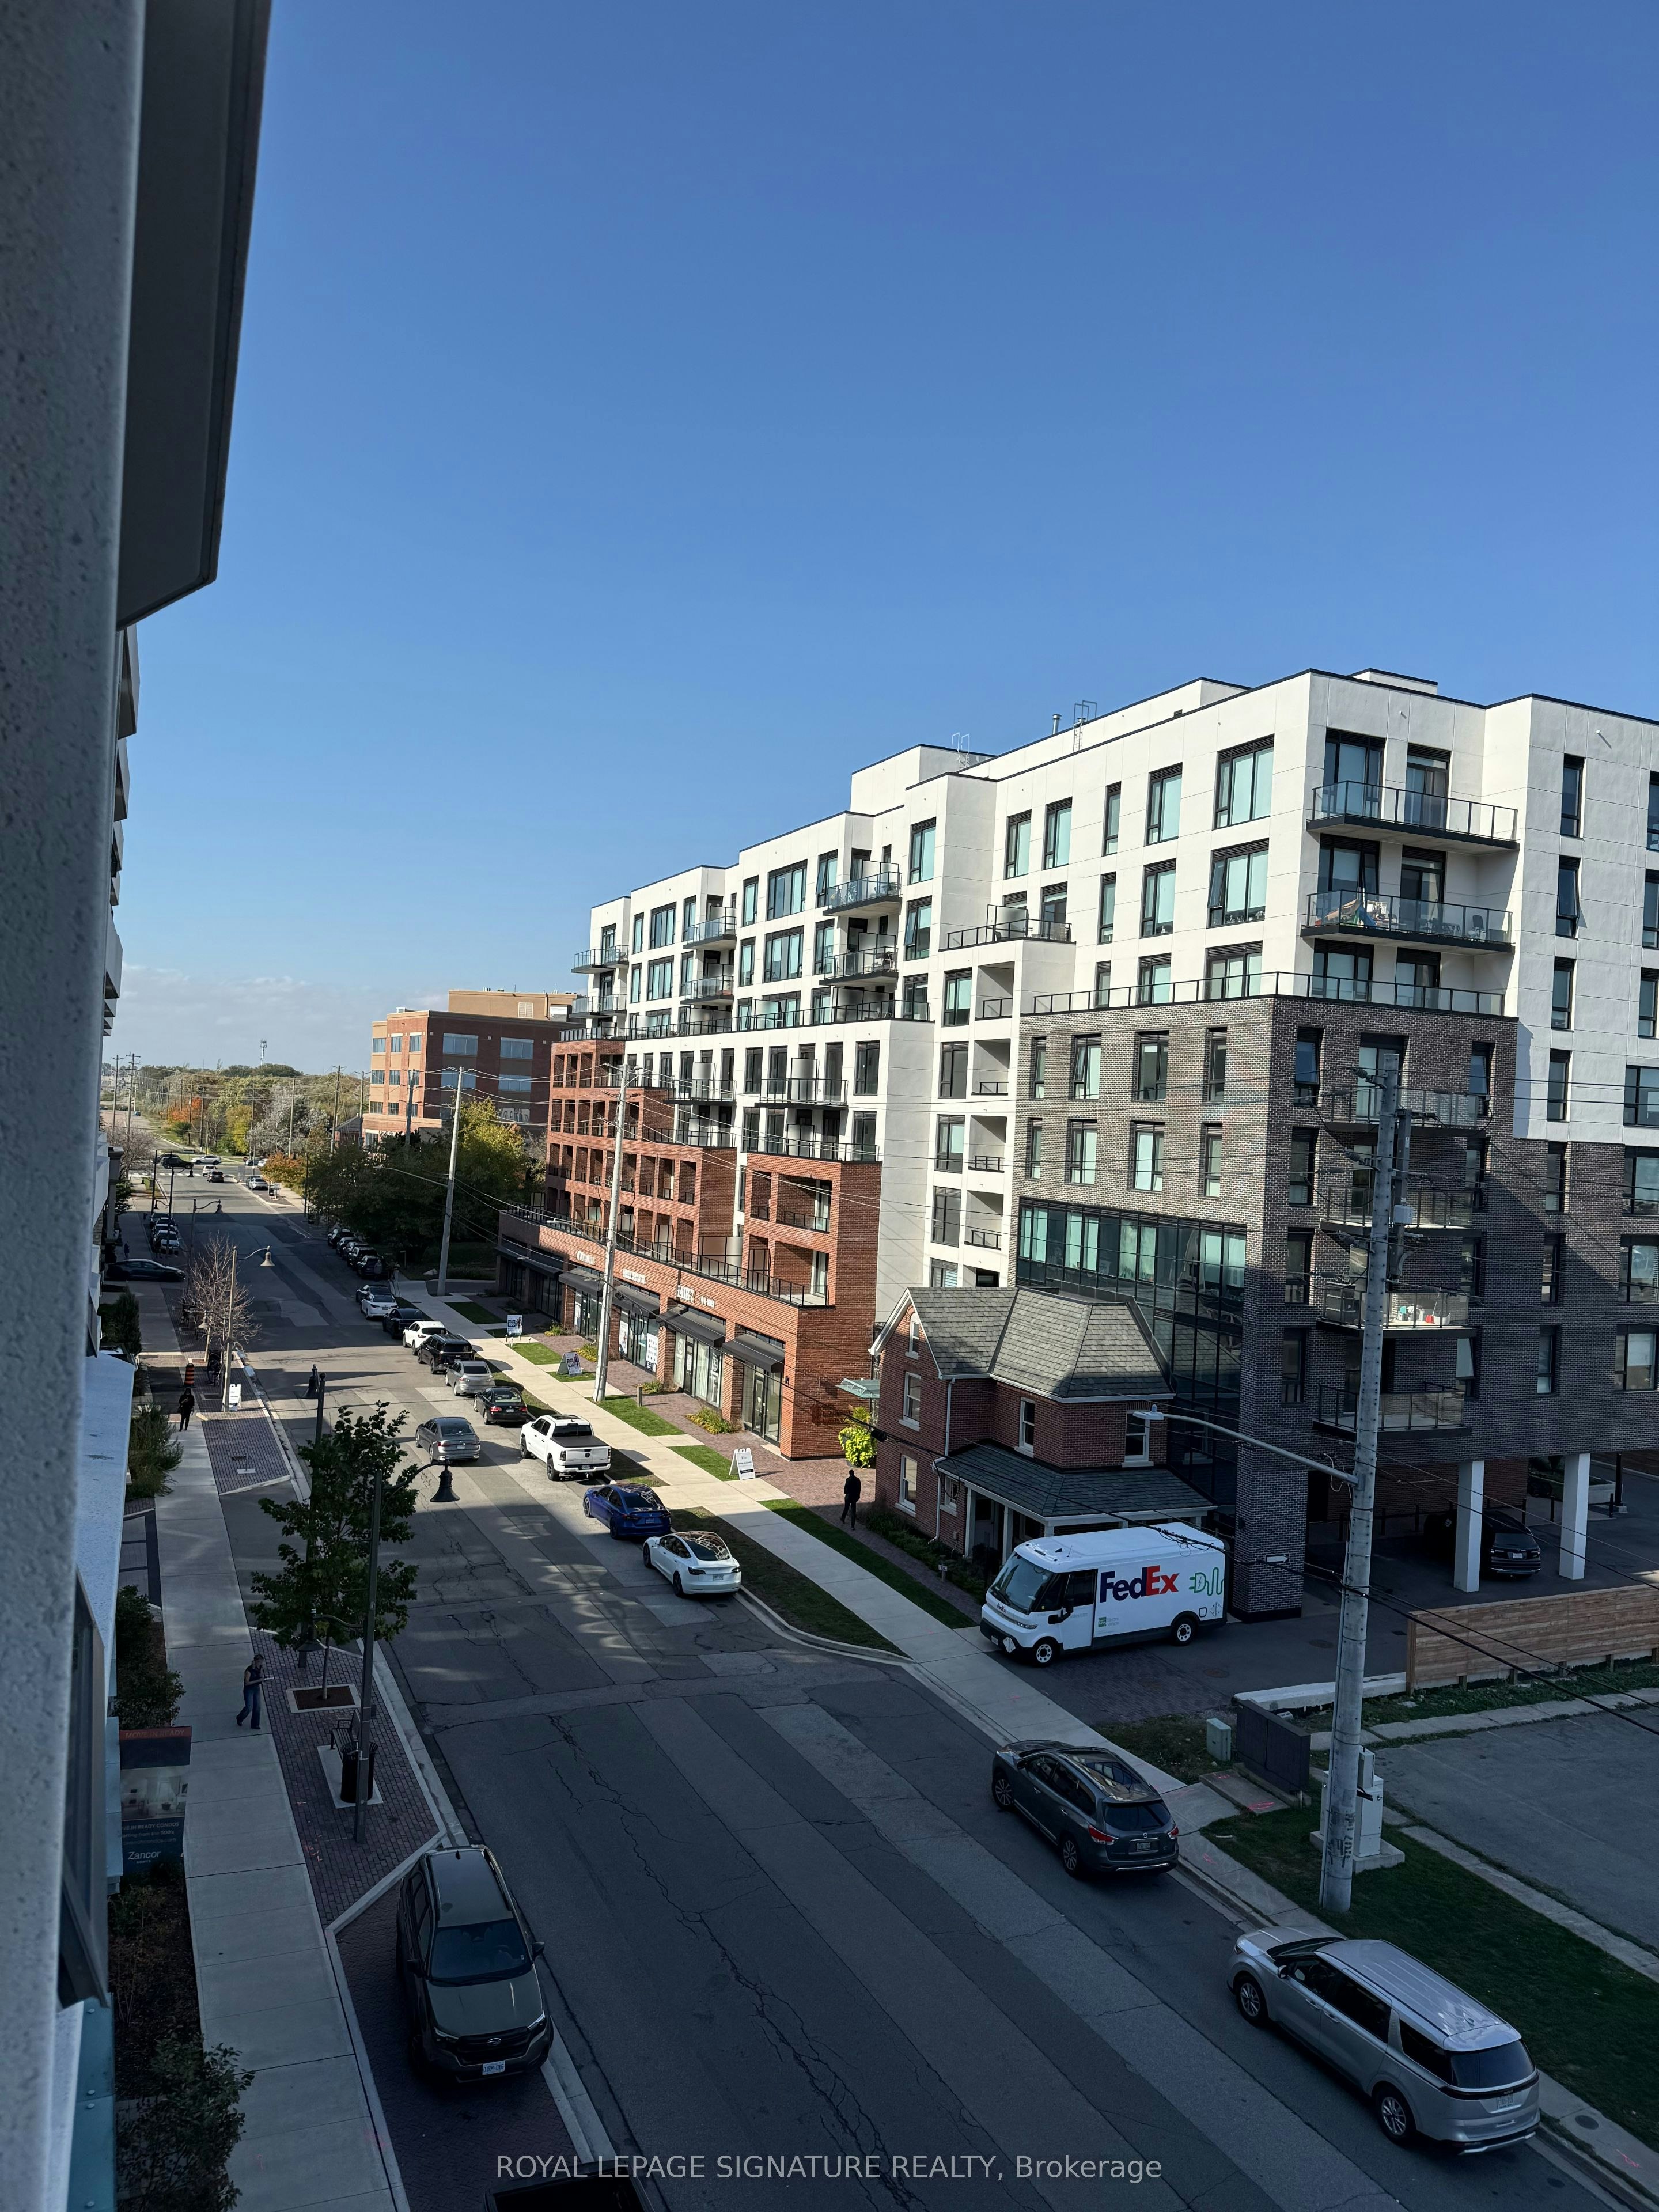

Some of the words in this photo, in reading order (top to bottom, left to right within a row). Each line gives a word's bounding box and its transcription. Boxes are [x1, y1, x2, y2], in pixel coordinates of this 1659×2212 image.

[1100, 1565, 1180, 1603] FedEx
[160, 1729, 185, 1737] READY
[128, 1851, 161, 1861] Zancor
